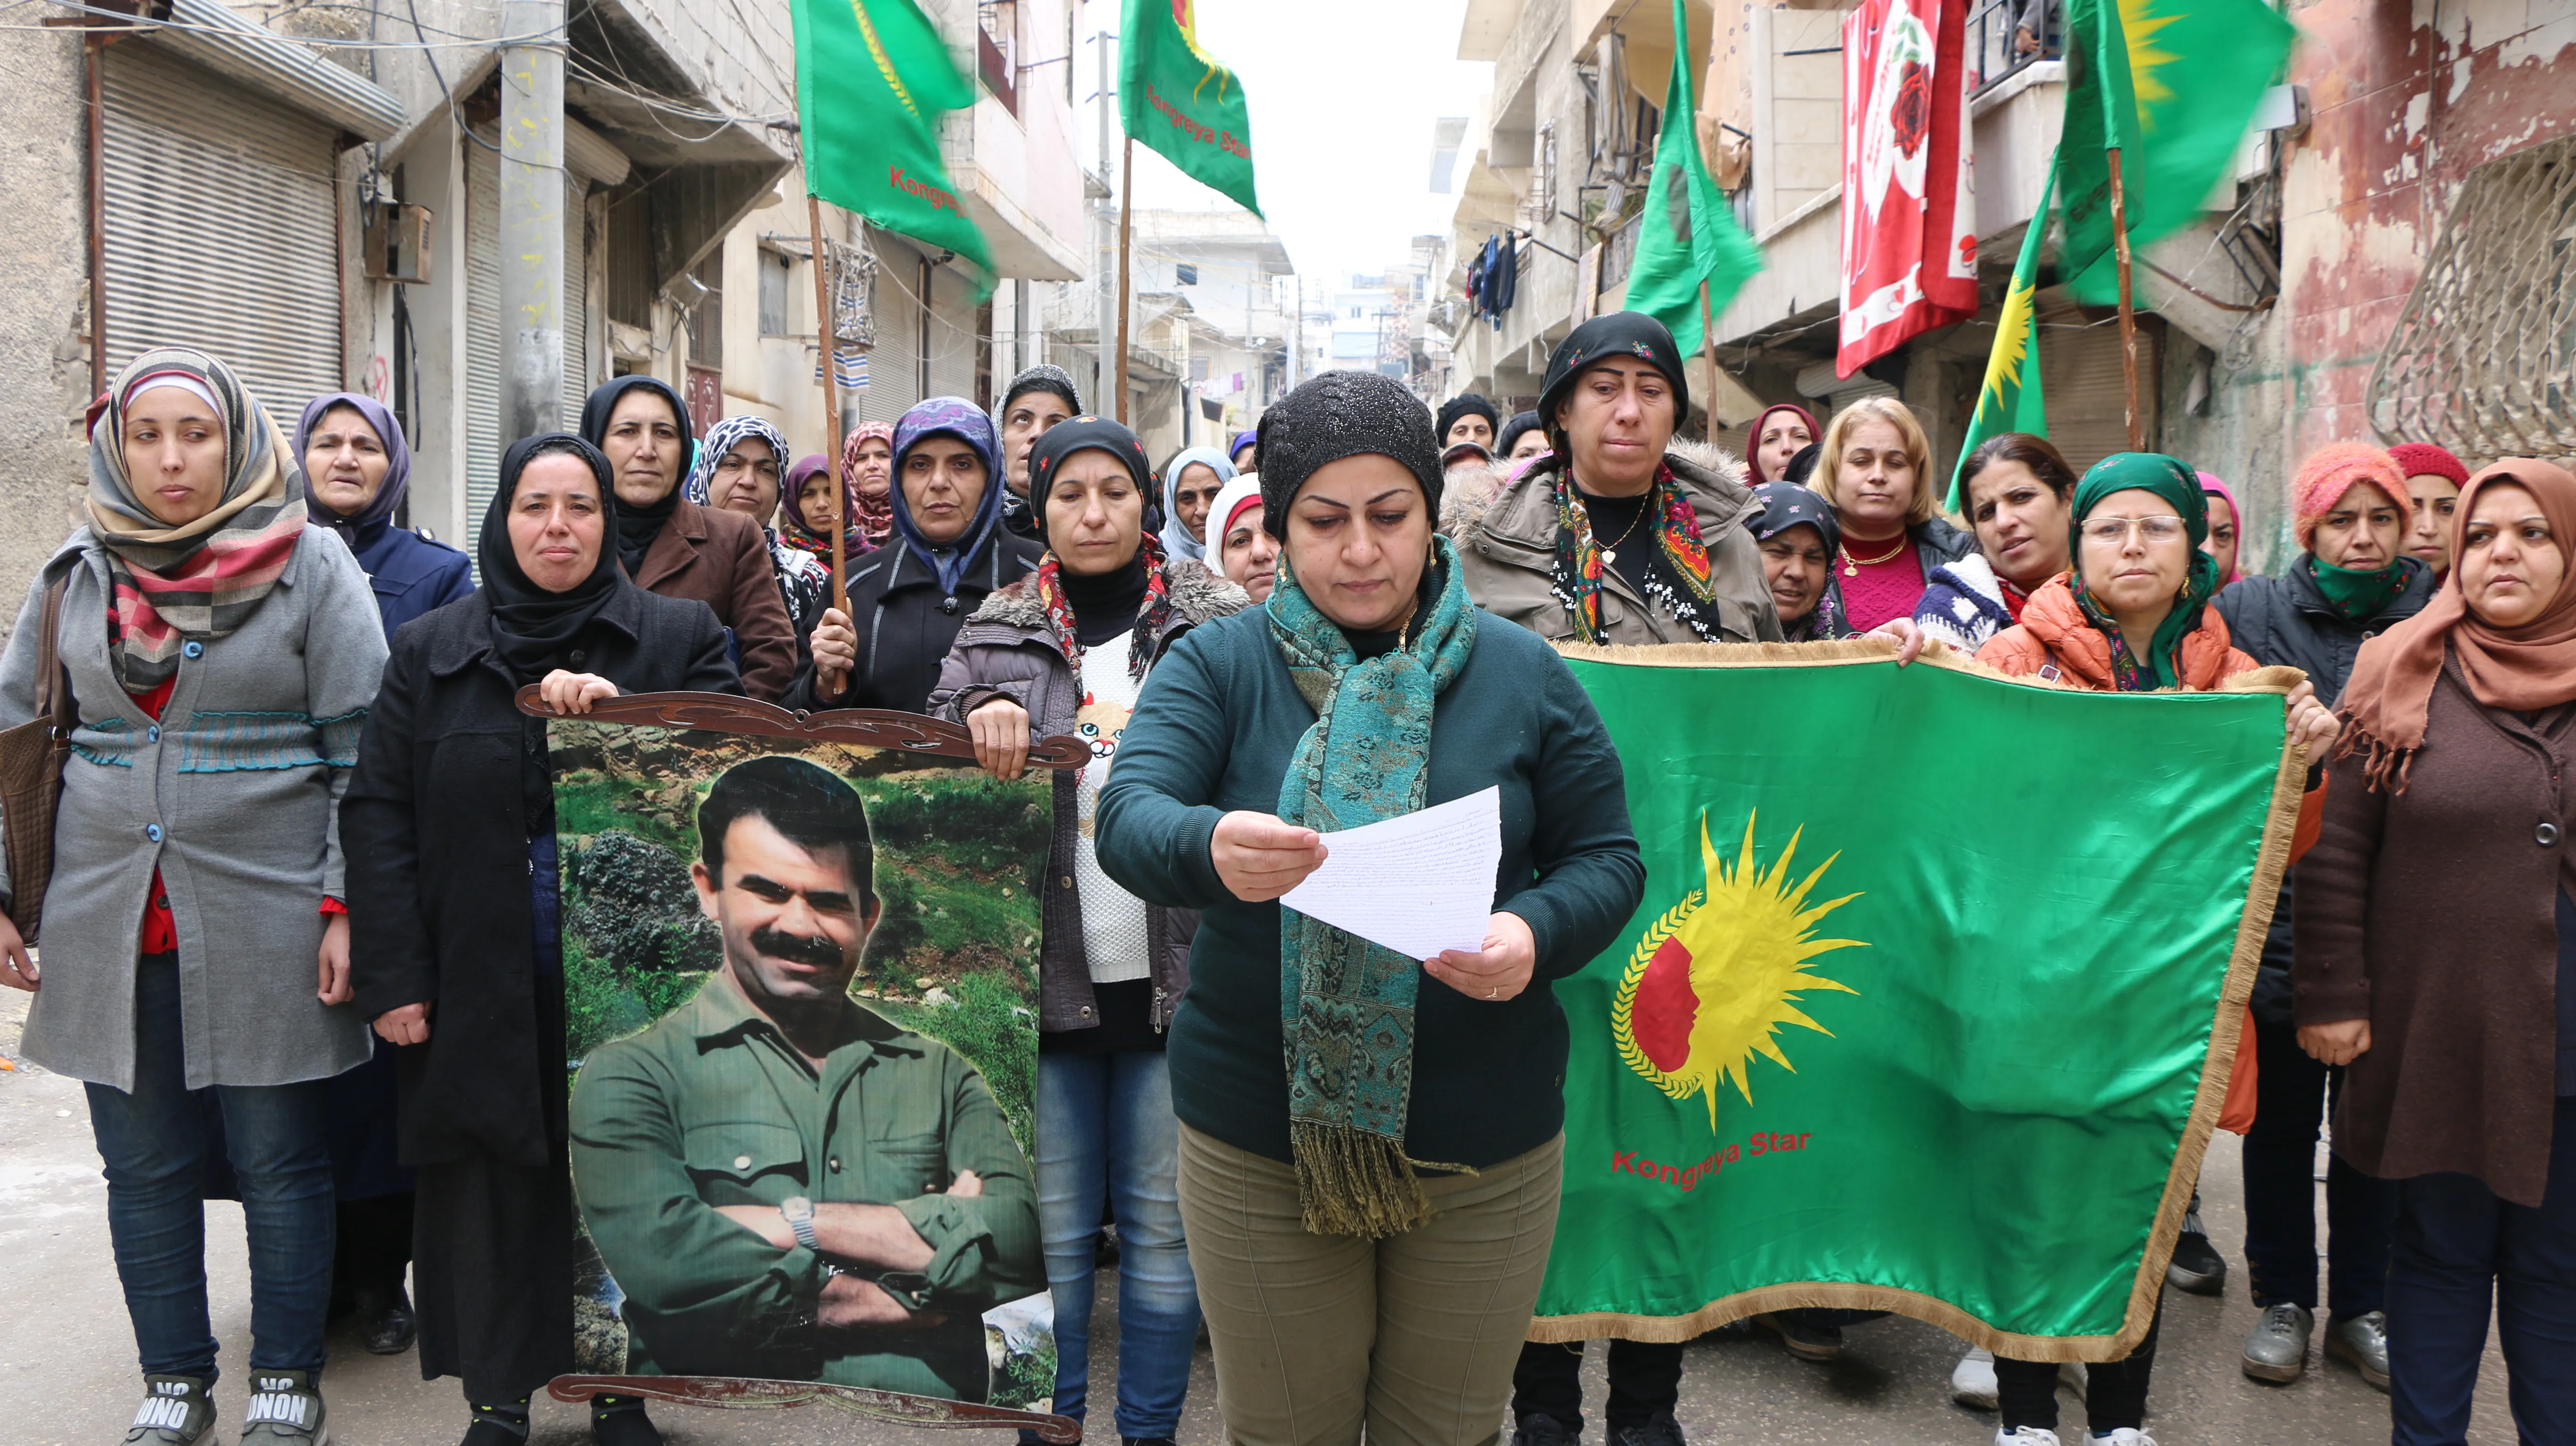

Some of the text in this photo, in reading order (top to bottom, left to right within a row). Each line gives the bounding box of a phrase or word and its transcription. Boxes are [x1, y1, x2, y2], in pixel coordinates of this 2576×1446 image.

[1219, 130, 1251, 160] Sta
[1611, 1131, 1812, 1191] Kongreya Star
